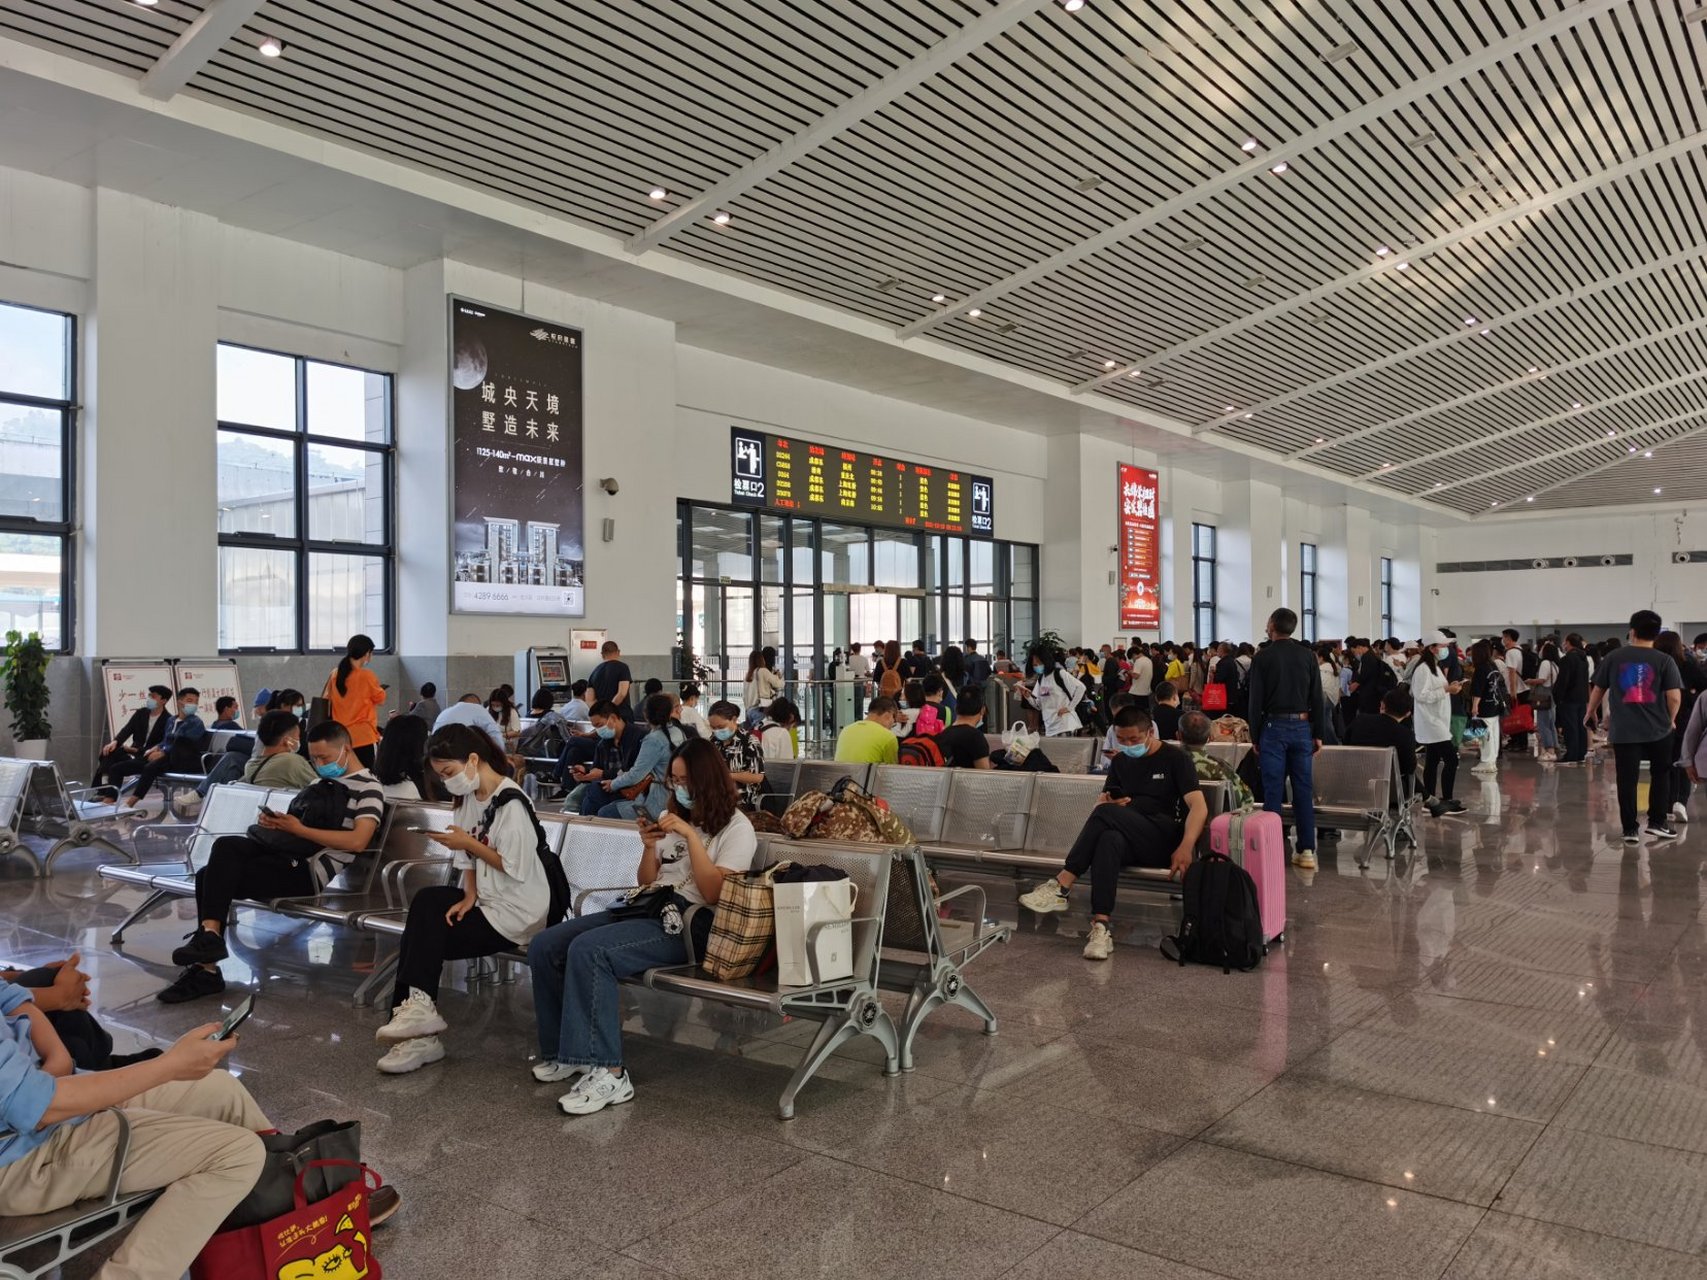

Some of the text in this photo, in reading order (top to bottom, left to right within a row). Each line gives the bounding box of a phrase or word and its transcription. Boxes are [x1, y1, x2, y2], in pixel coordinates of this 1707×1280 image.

[481, 380, 559, 415] 城央天境
[481, 410, 559, 442] 墅造未来
[734, 478, 764, 498] 检票口2
